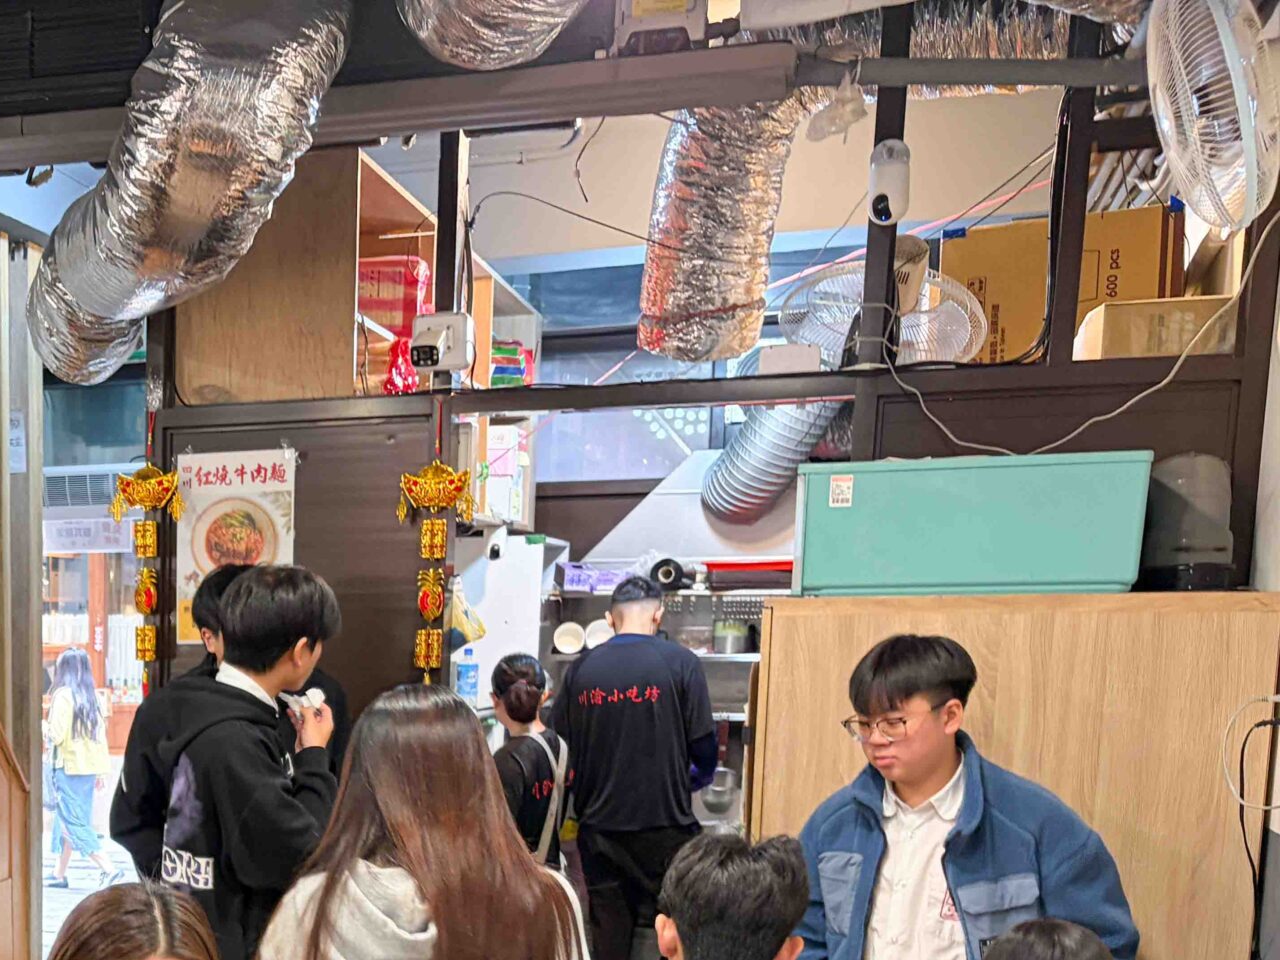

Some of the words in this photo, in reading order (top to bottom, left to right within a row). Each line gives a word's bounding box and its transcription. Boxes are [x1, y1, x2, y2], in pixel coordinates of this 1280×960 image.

[1110, 248, 1121, 270] pcs
[1106, 274, 1118, 298] 600
[182, 466, 193, 489] 四川
[578, 684, 660, 706] 川渝小吃坊
